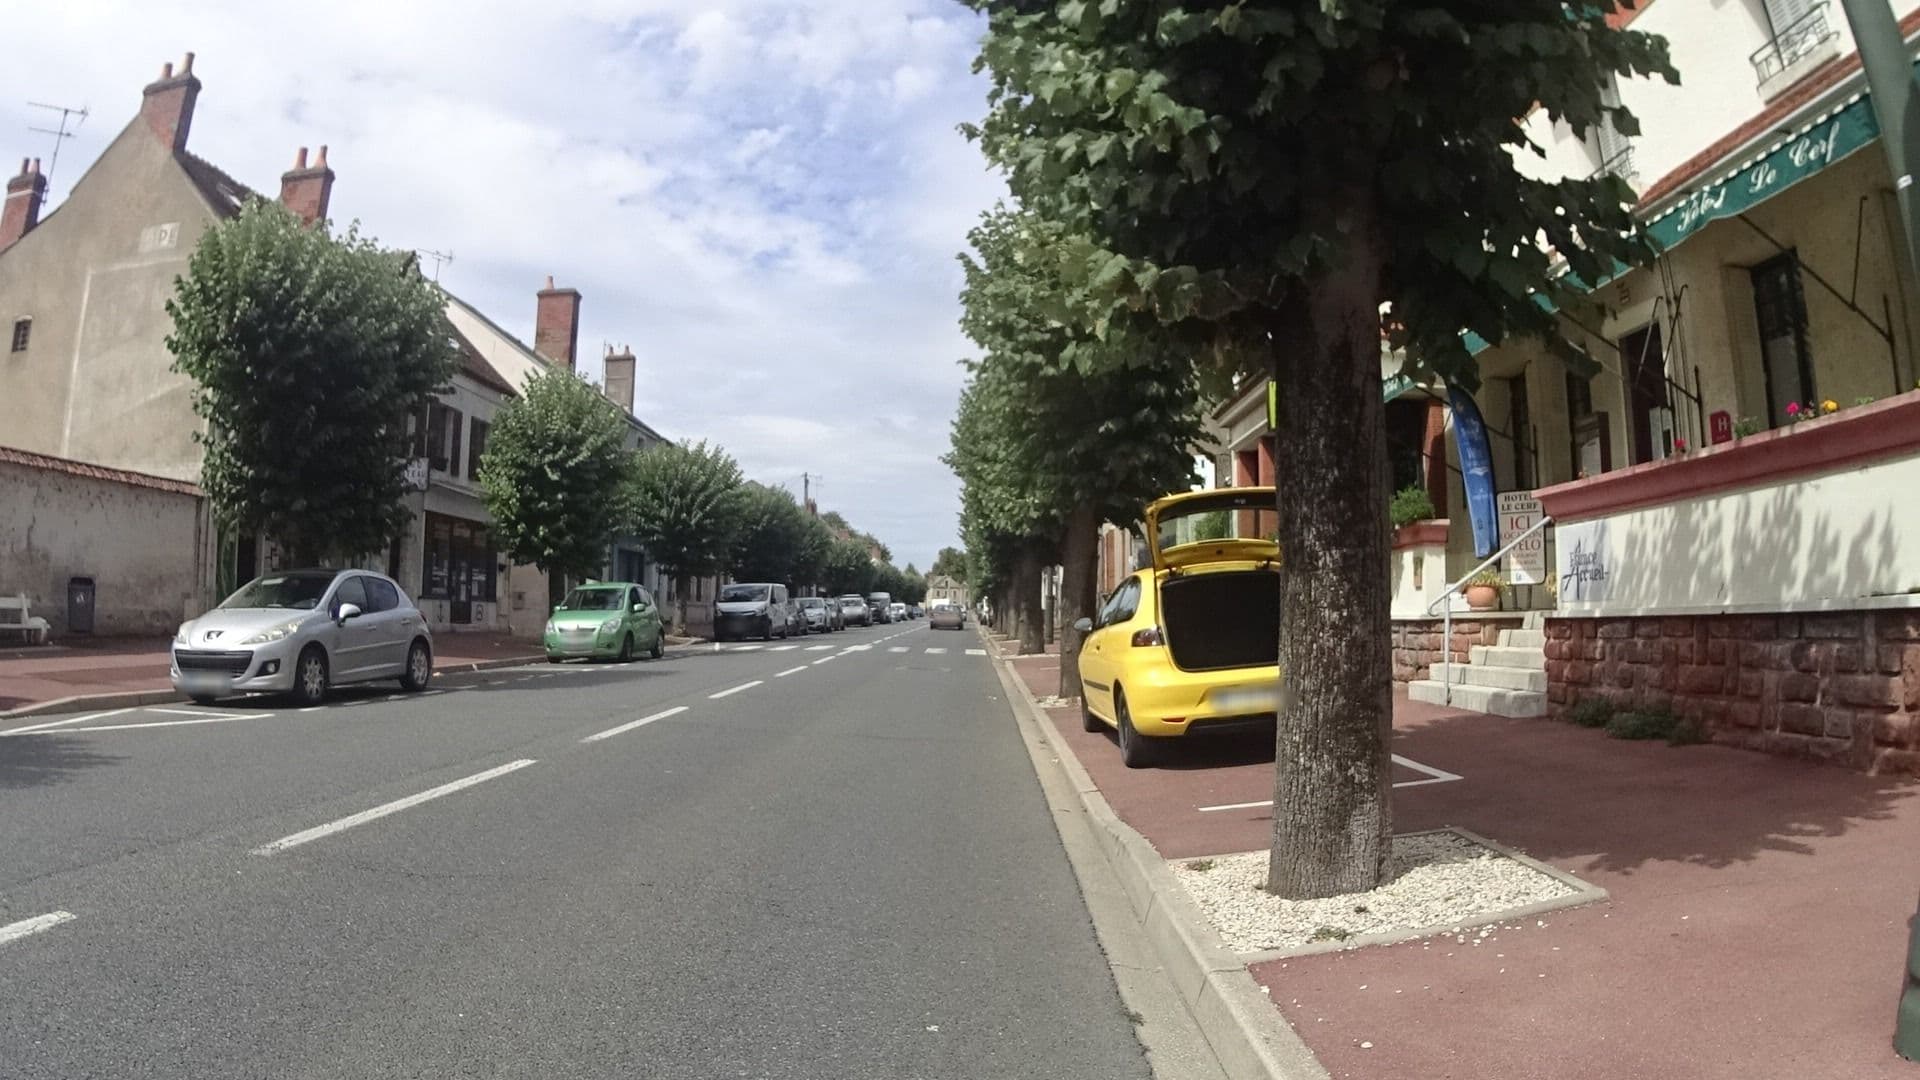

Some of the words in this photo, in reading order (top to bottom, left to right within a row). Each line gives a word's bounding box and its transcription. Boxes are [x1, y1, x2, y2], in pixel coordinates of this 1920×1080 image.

[1789, 121, 1839, 167] Cerf
[1717, 416, 1728, 433] H
[1501, 503, 1512, 511] LE
[1514, 502, 1538, 510] CERF
[1510, 515, 1530, 530] ICI
